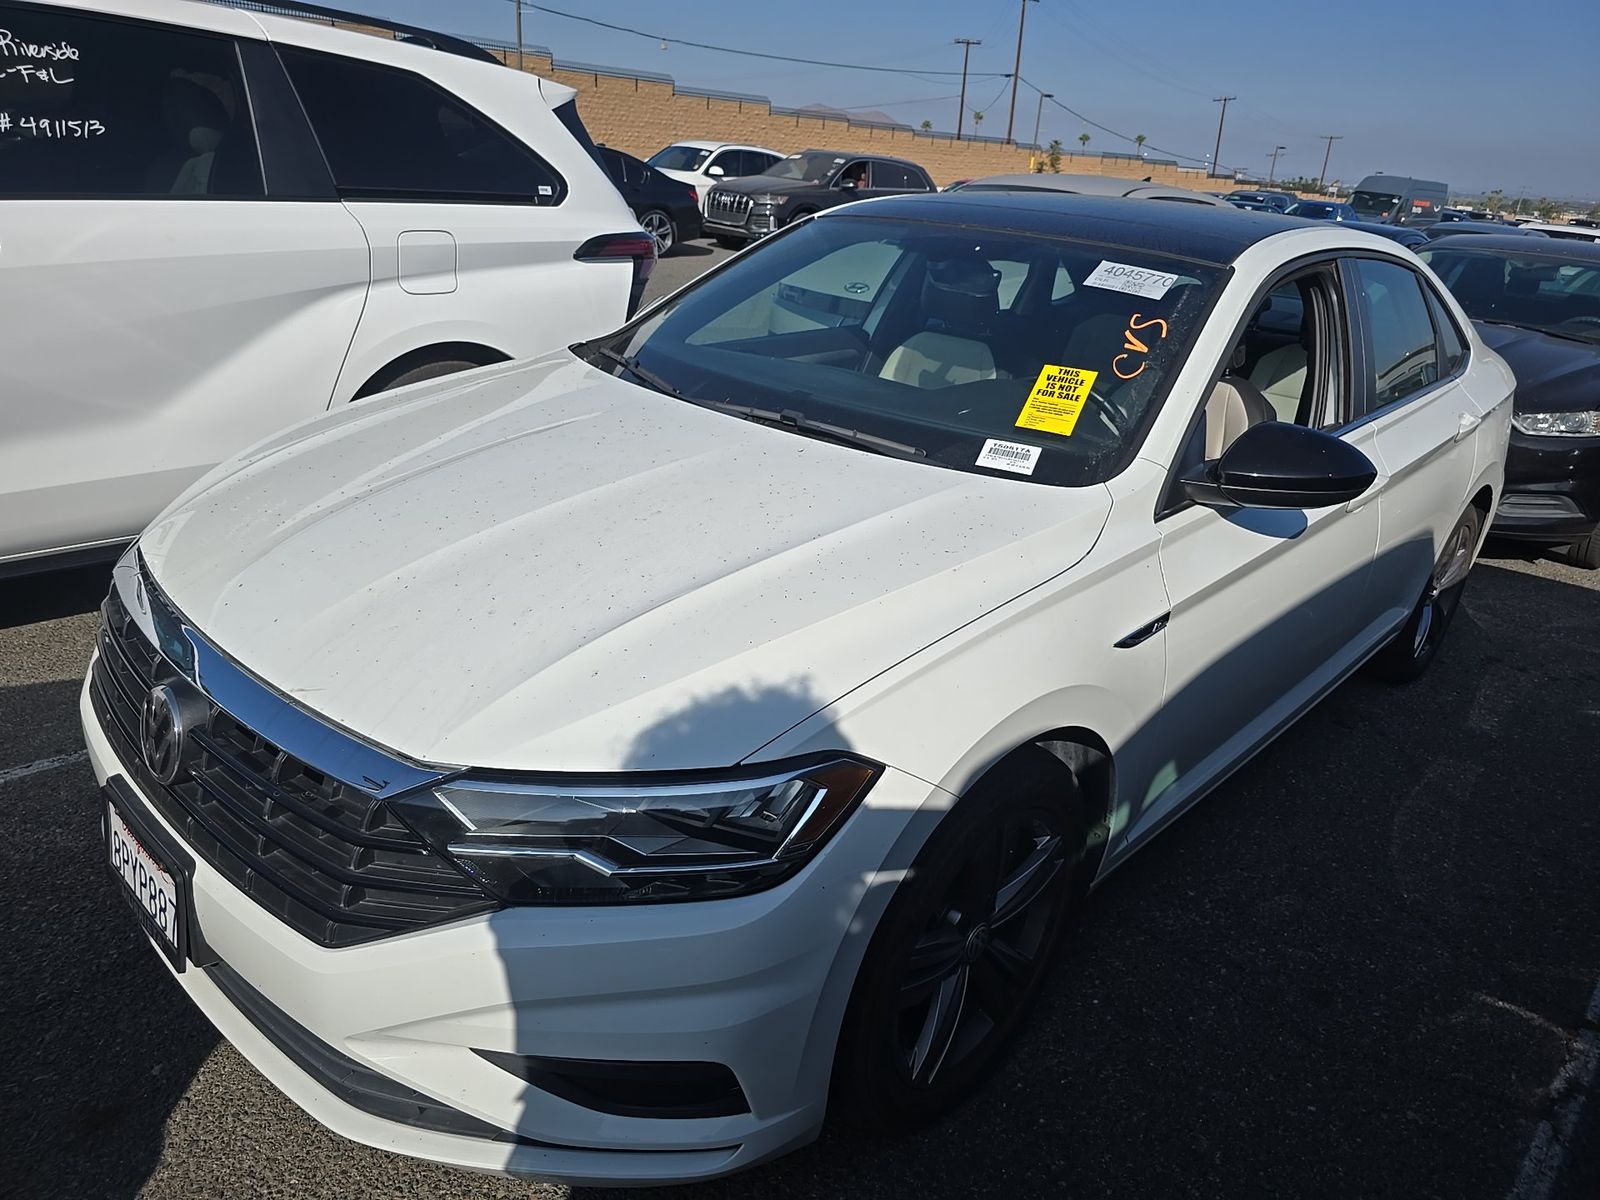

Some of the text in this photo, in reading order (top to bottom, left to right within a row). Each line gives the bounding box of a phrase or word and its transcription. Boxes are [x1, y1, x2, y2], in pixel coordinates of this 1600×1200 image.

[0, 29, 79, 60] Riverside
[1104, 266, 1175, 287] 4045770
[1058, 368, 1080, 377] THIS
[1045, 382, 1079, 393] IS NOT
[1046, 374, 1085, 387] VEHICLE
[1036, 388, 1081, 402] FOR SALE
[113, 830, 177, 948] 8PYP887
